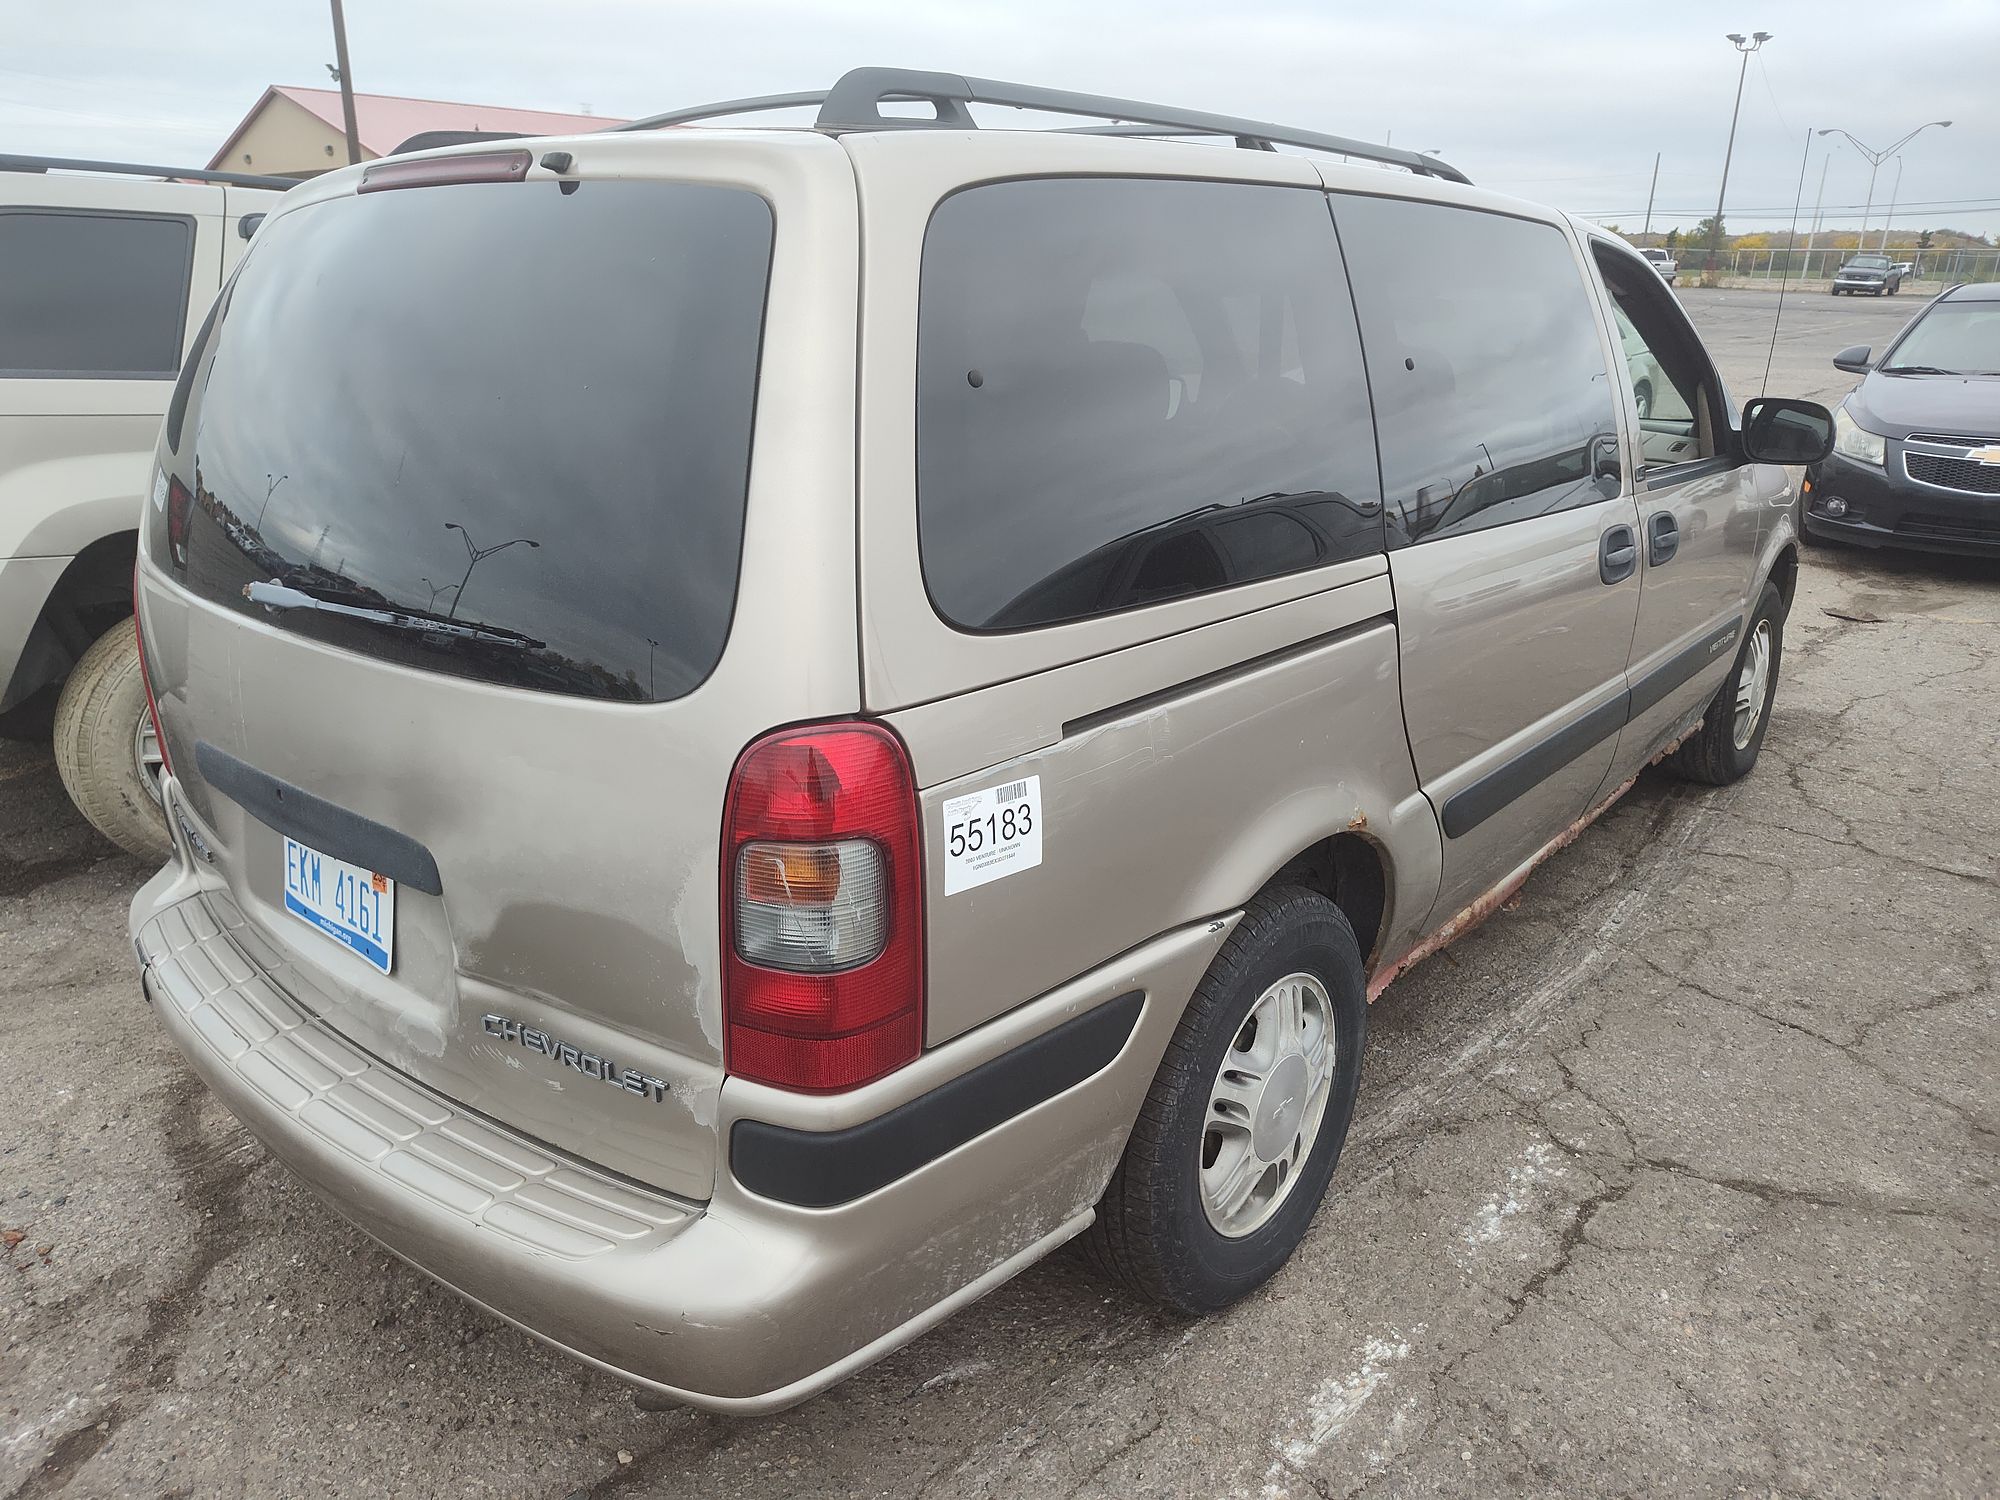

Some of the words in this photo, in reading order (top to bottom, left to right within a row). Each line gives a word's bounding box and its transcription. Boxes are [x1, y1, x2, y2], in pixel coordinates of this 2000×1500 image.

[950, 803, 1032, 858] 55183
[287, 840, 322, 907] EKM
[335, 868, 383, 944] 4161
[319, 917, 352, 946] michigan.org
[480, 1012, 670, 1103] CHEVROLET
